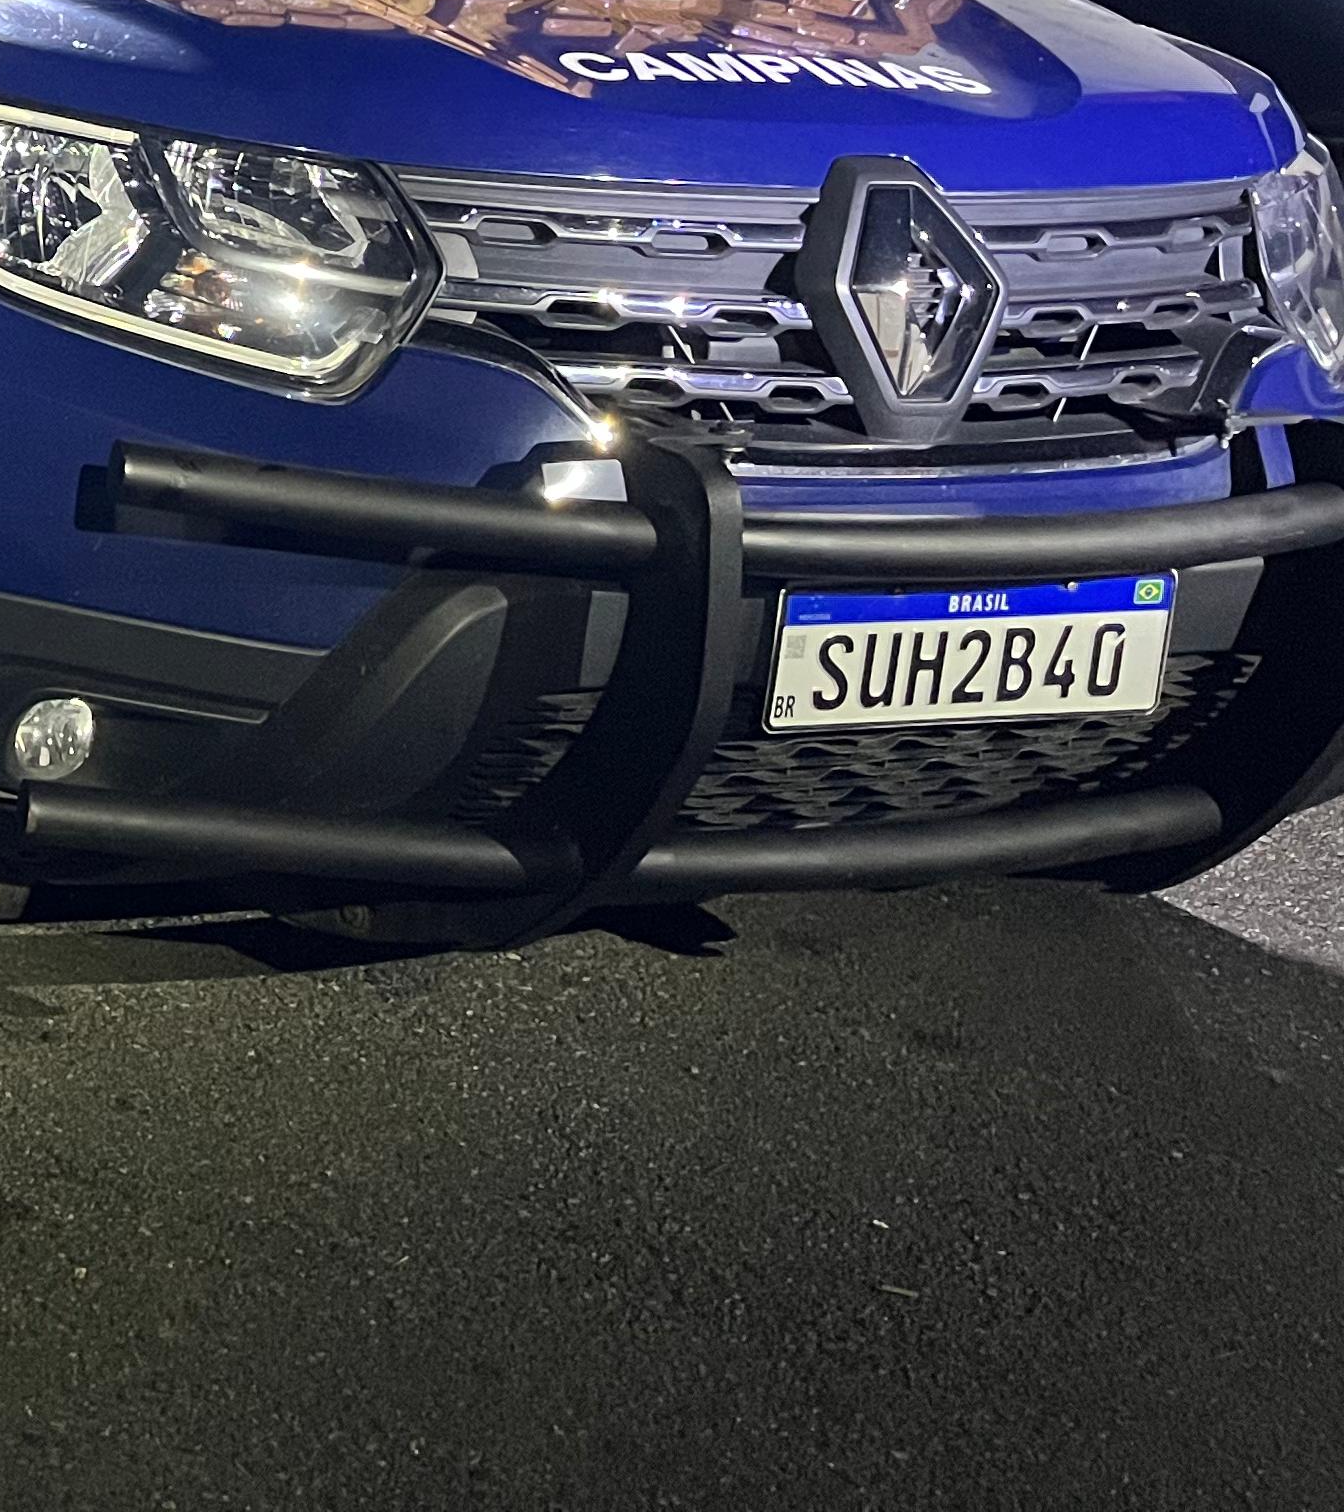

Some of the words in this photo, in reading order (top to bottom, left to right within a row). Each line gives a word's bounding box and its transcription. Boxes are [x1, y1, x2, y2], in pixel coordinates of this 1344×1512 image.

[559, 50, 993, 96] CAMPINAS
[948, 593, 1009, 613] BRASIL
[812, 622, 1128, 711] SUH2B40
[773, 695, 796, 718] BR
